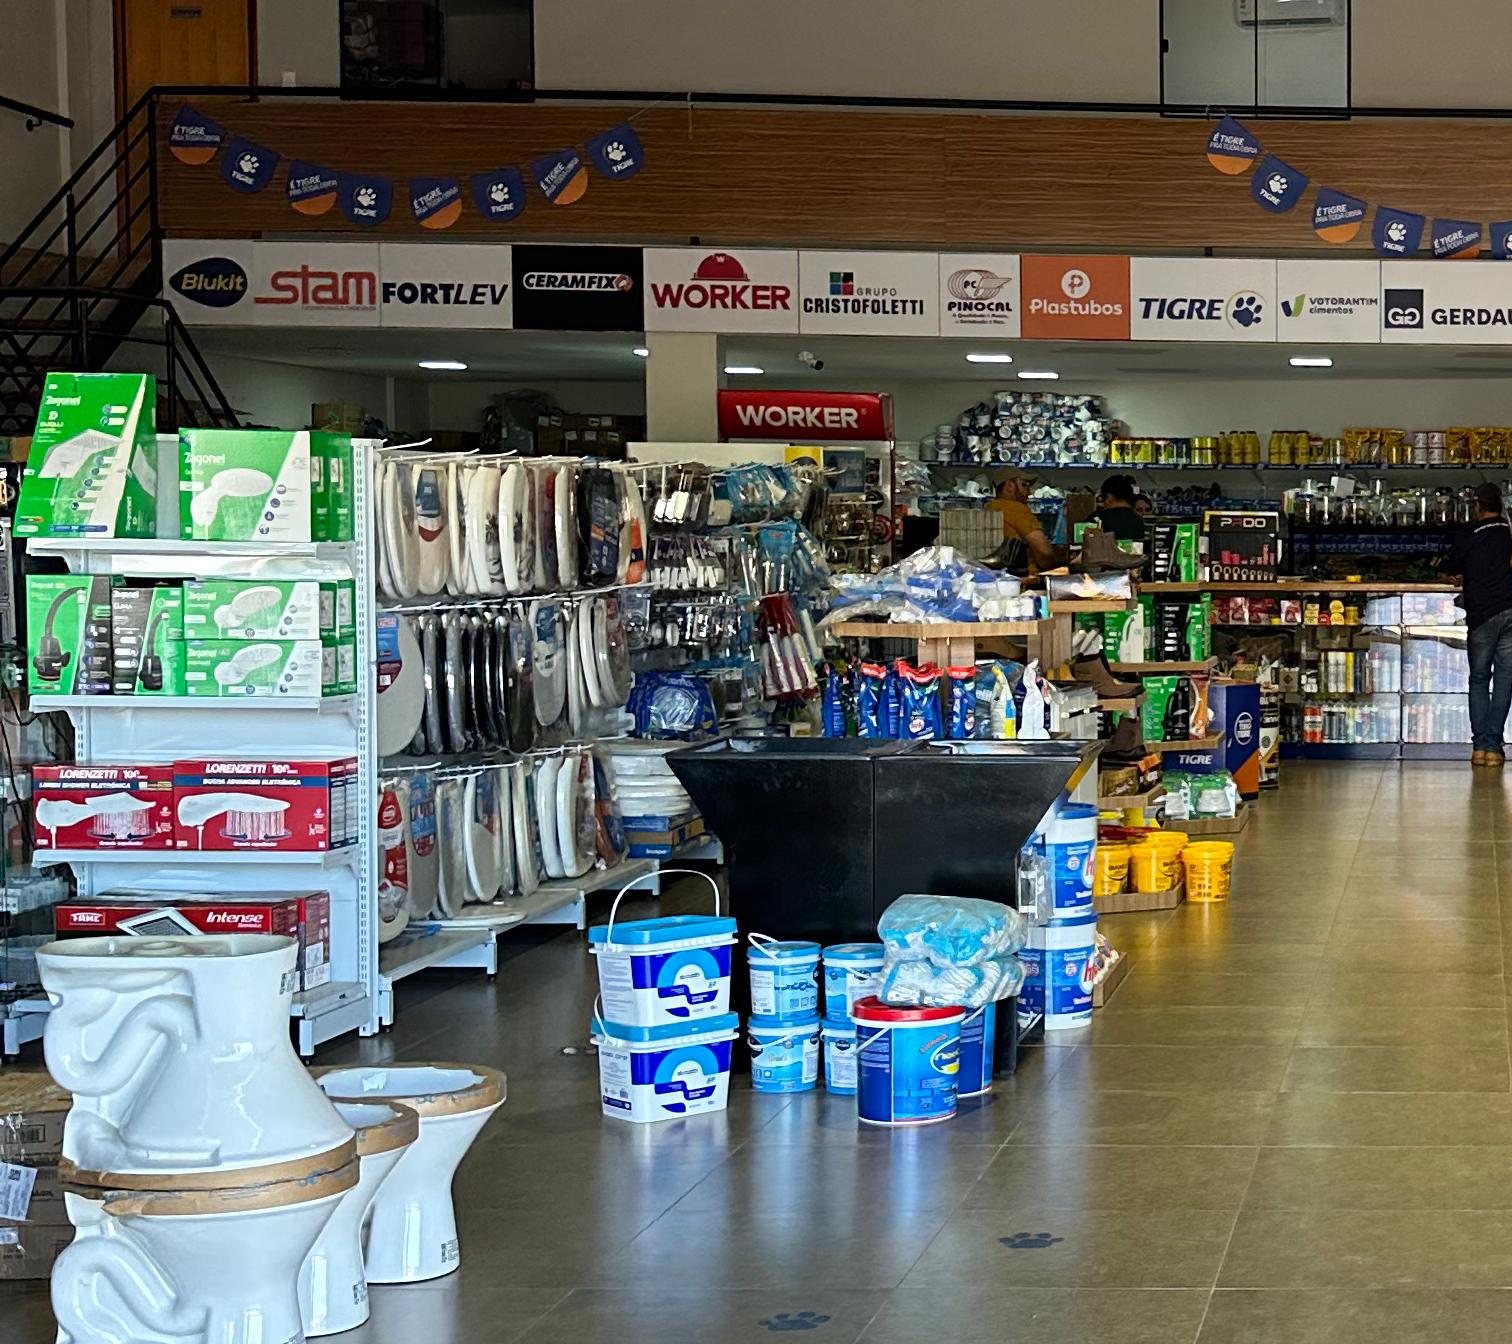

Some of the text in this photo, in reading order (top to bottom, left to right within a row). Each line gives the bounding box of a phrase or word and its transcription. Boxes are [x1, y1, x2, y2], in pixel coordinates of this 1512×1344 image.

[181, 126, 206, 136] TIGRE
[1220, 135, 1245, 146] TIGRE
[612, 158, 635, 173] TIGRE
[232, 170, 255, 185] TIGRE
[296, 175, 321, 187] TIGRE
[419, 187, 442, 206] TIGRE
[1260, 188, 1281, 206] TIGRE
[353, 207, 378, 217] TIGRE
[490, 202, 514, 213] TIGRE
[1322, 204, 1347, 215] TIGRE
[1439, 229, 1464, 246] TIGRE
[1383, 241, 1406, 253] TIGRE
[181, 273, 244, 292] Blukit
[254, 264, 376, 305] stam
[524, 274, 617, 290] CERAMFIX
[964, 280, 977, 289] PC
[381, 282, 509, 305] FORTLEV
[650, 283, 790, 311] WORKER
[856, 288, 897, 297] GRUPO
[803, 298, 924, 316] CRISTOFOLETTI
[947, 301, 1012, 312] PINOCAL
[1029, 299, 1123, 315] Plastubos
[1309, 297, 1378, 306] VOTORANTIM
[1138, 298, 1224, 321] TIGRE
[1309, 306, 1353, 315] cimentos
[736, 404, 858, 429] WORKER
[184, 452, 226, 466] Zagonel
[1178, 754, 1213, 765] TIGRE
[59, 769, 118, 779] LORENZETTI
[205, 763, 267, 774] LORENZETTI
[206, 911, 264, 924] Intense
